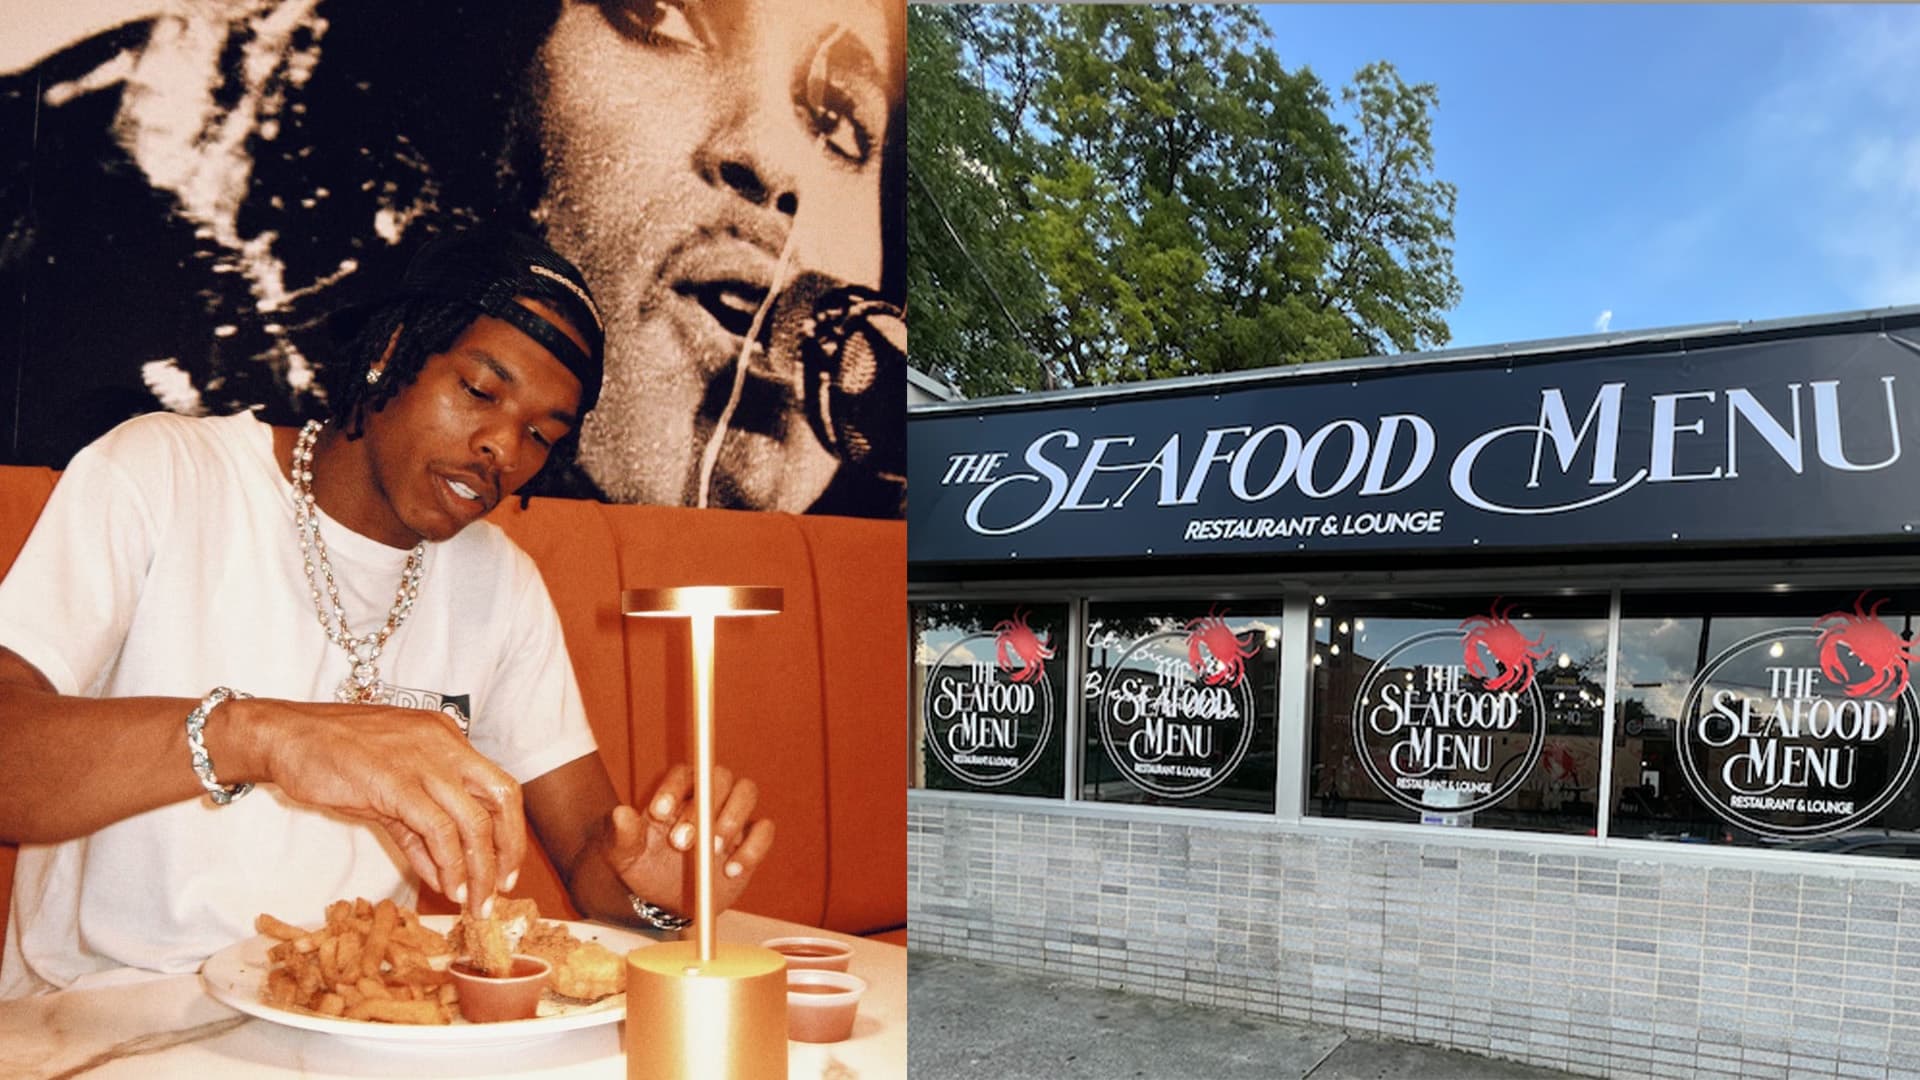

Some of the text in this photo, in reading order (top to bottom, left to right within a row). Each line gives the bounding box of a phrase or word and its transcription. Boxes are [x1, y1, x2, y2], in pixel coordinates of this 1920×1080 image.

[941, 376, 1902, 536] THE SEAFOOD MENU
[1184, 511, 1445, 541] RESTAURANT & LOUNGE
[969, 660, 999, 686] THE
[1422, 664, 1467, 696] THE
[1765, 667, 1823, 700] THE
[934, 676, 1035, 719] SEAFOOD
[1113, 678, 1231, 724] SEAFOOD
[1370, 684, 1519, 735] SEAFOOD
[1699, 690, 1887, 747] SEAFOOD
[948, 712, 1018, 754] MENU
[1129, 717, 1212, 763] MENU
[1390, 727, 1493, 778] MENU
[1396, 777, 1447, 791] RESTAURANT
[1456, 781, 1493, 794] LOUNGE
[1722, 738, 1855, 795] MENU
[1730, 795, 1854, 815] RESTAURANT & LOUNGE
